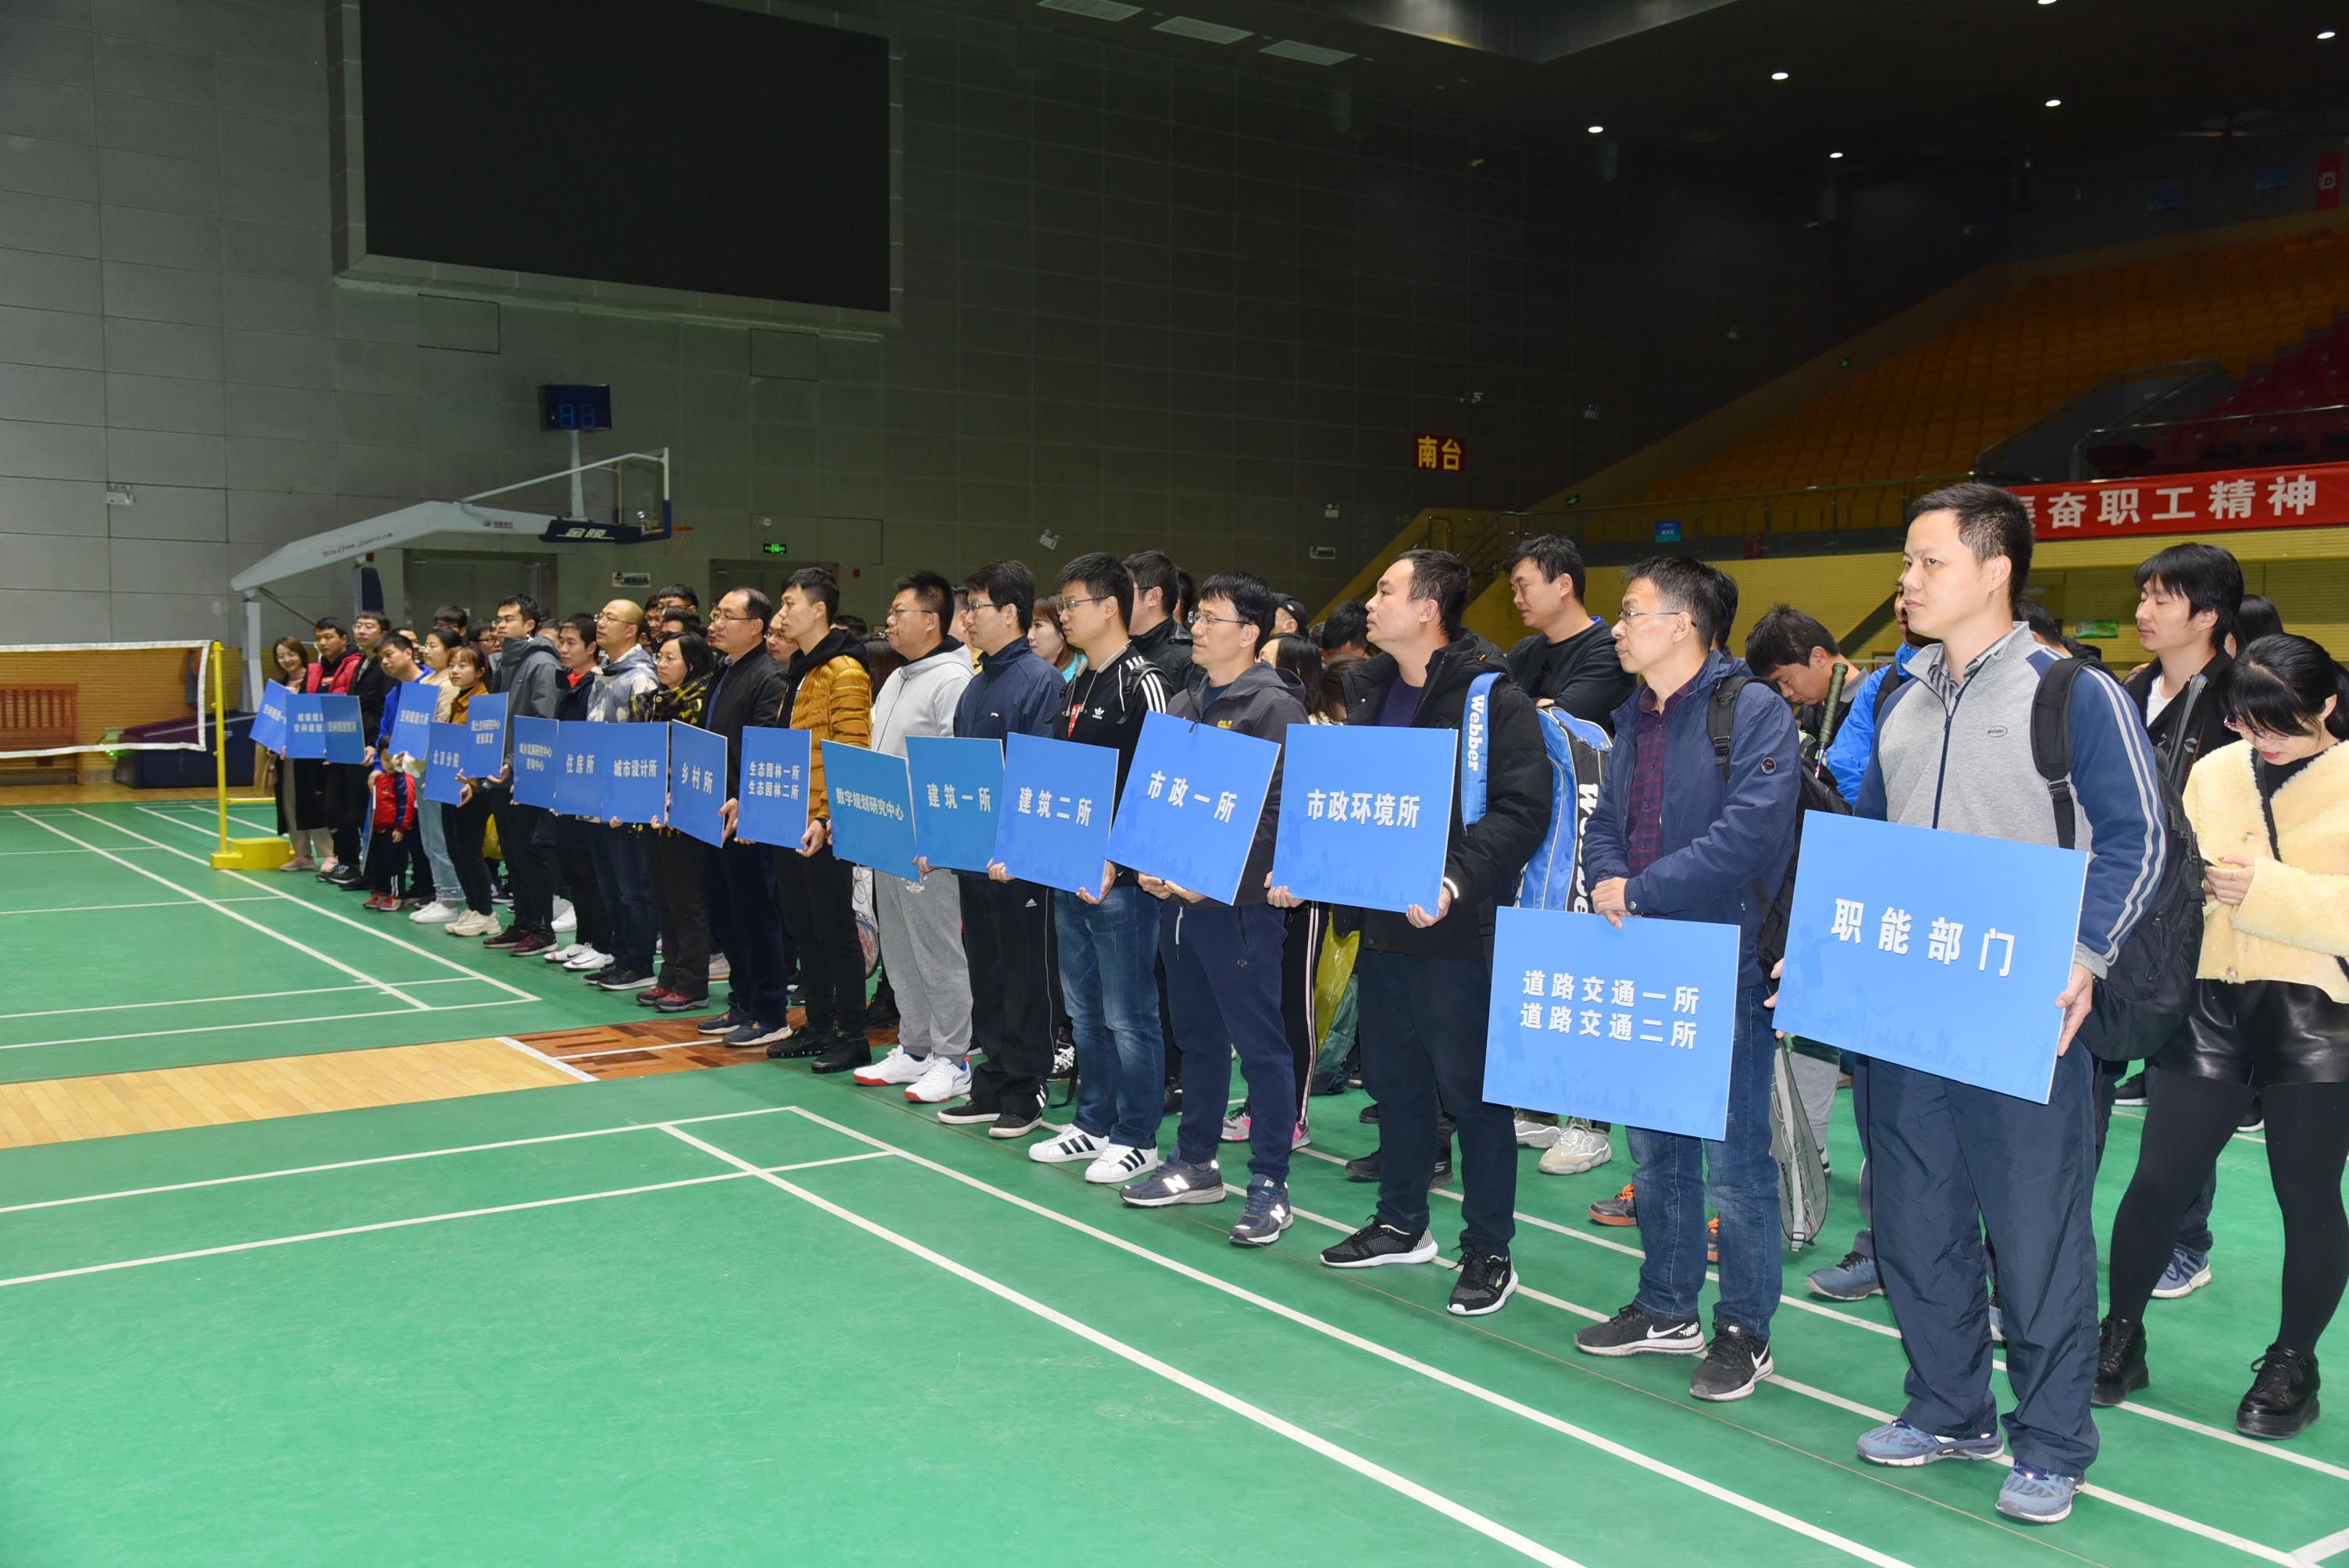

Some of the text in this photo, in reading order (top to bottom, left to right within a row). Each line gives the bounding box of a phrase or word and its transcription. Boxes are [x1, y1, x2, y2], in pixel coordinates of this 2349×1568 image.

[1417, 435, 1462, 471] 南台
[1467, 693, 1486, 772] Webber
[433, 749, 460, 768] 北京分院
[565, 753, 596, 775] 住房所
[613, 758, 658, 779] 城市设计所
[749, 761, 800, 781] 生态园林一所
[681, 761, 714, 795] 乡村所
[748, 779, 800, 800] 生态园林二所
[835, 786, 905, 821] 数字规划研究中心
[926, 782, 992, 813] 建筑一所
[1018, 786, 1093, 827] 建筑二所
[1146, 770, 1238, 824] 市政一所
[1306, 788, 1421, 829] 市政环境所
[1830, 898, 2016, 978] 职能部门
[1521, 969, 1700, 1016] 道路交通一所
[1520, 1002, 1698, 1051] 道路交通二所
